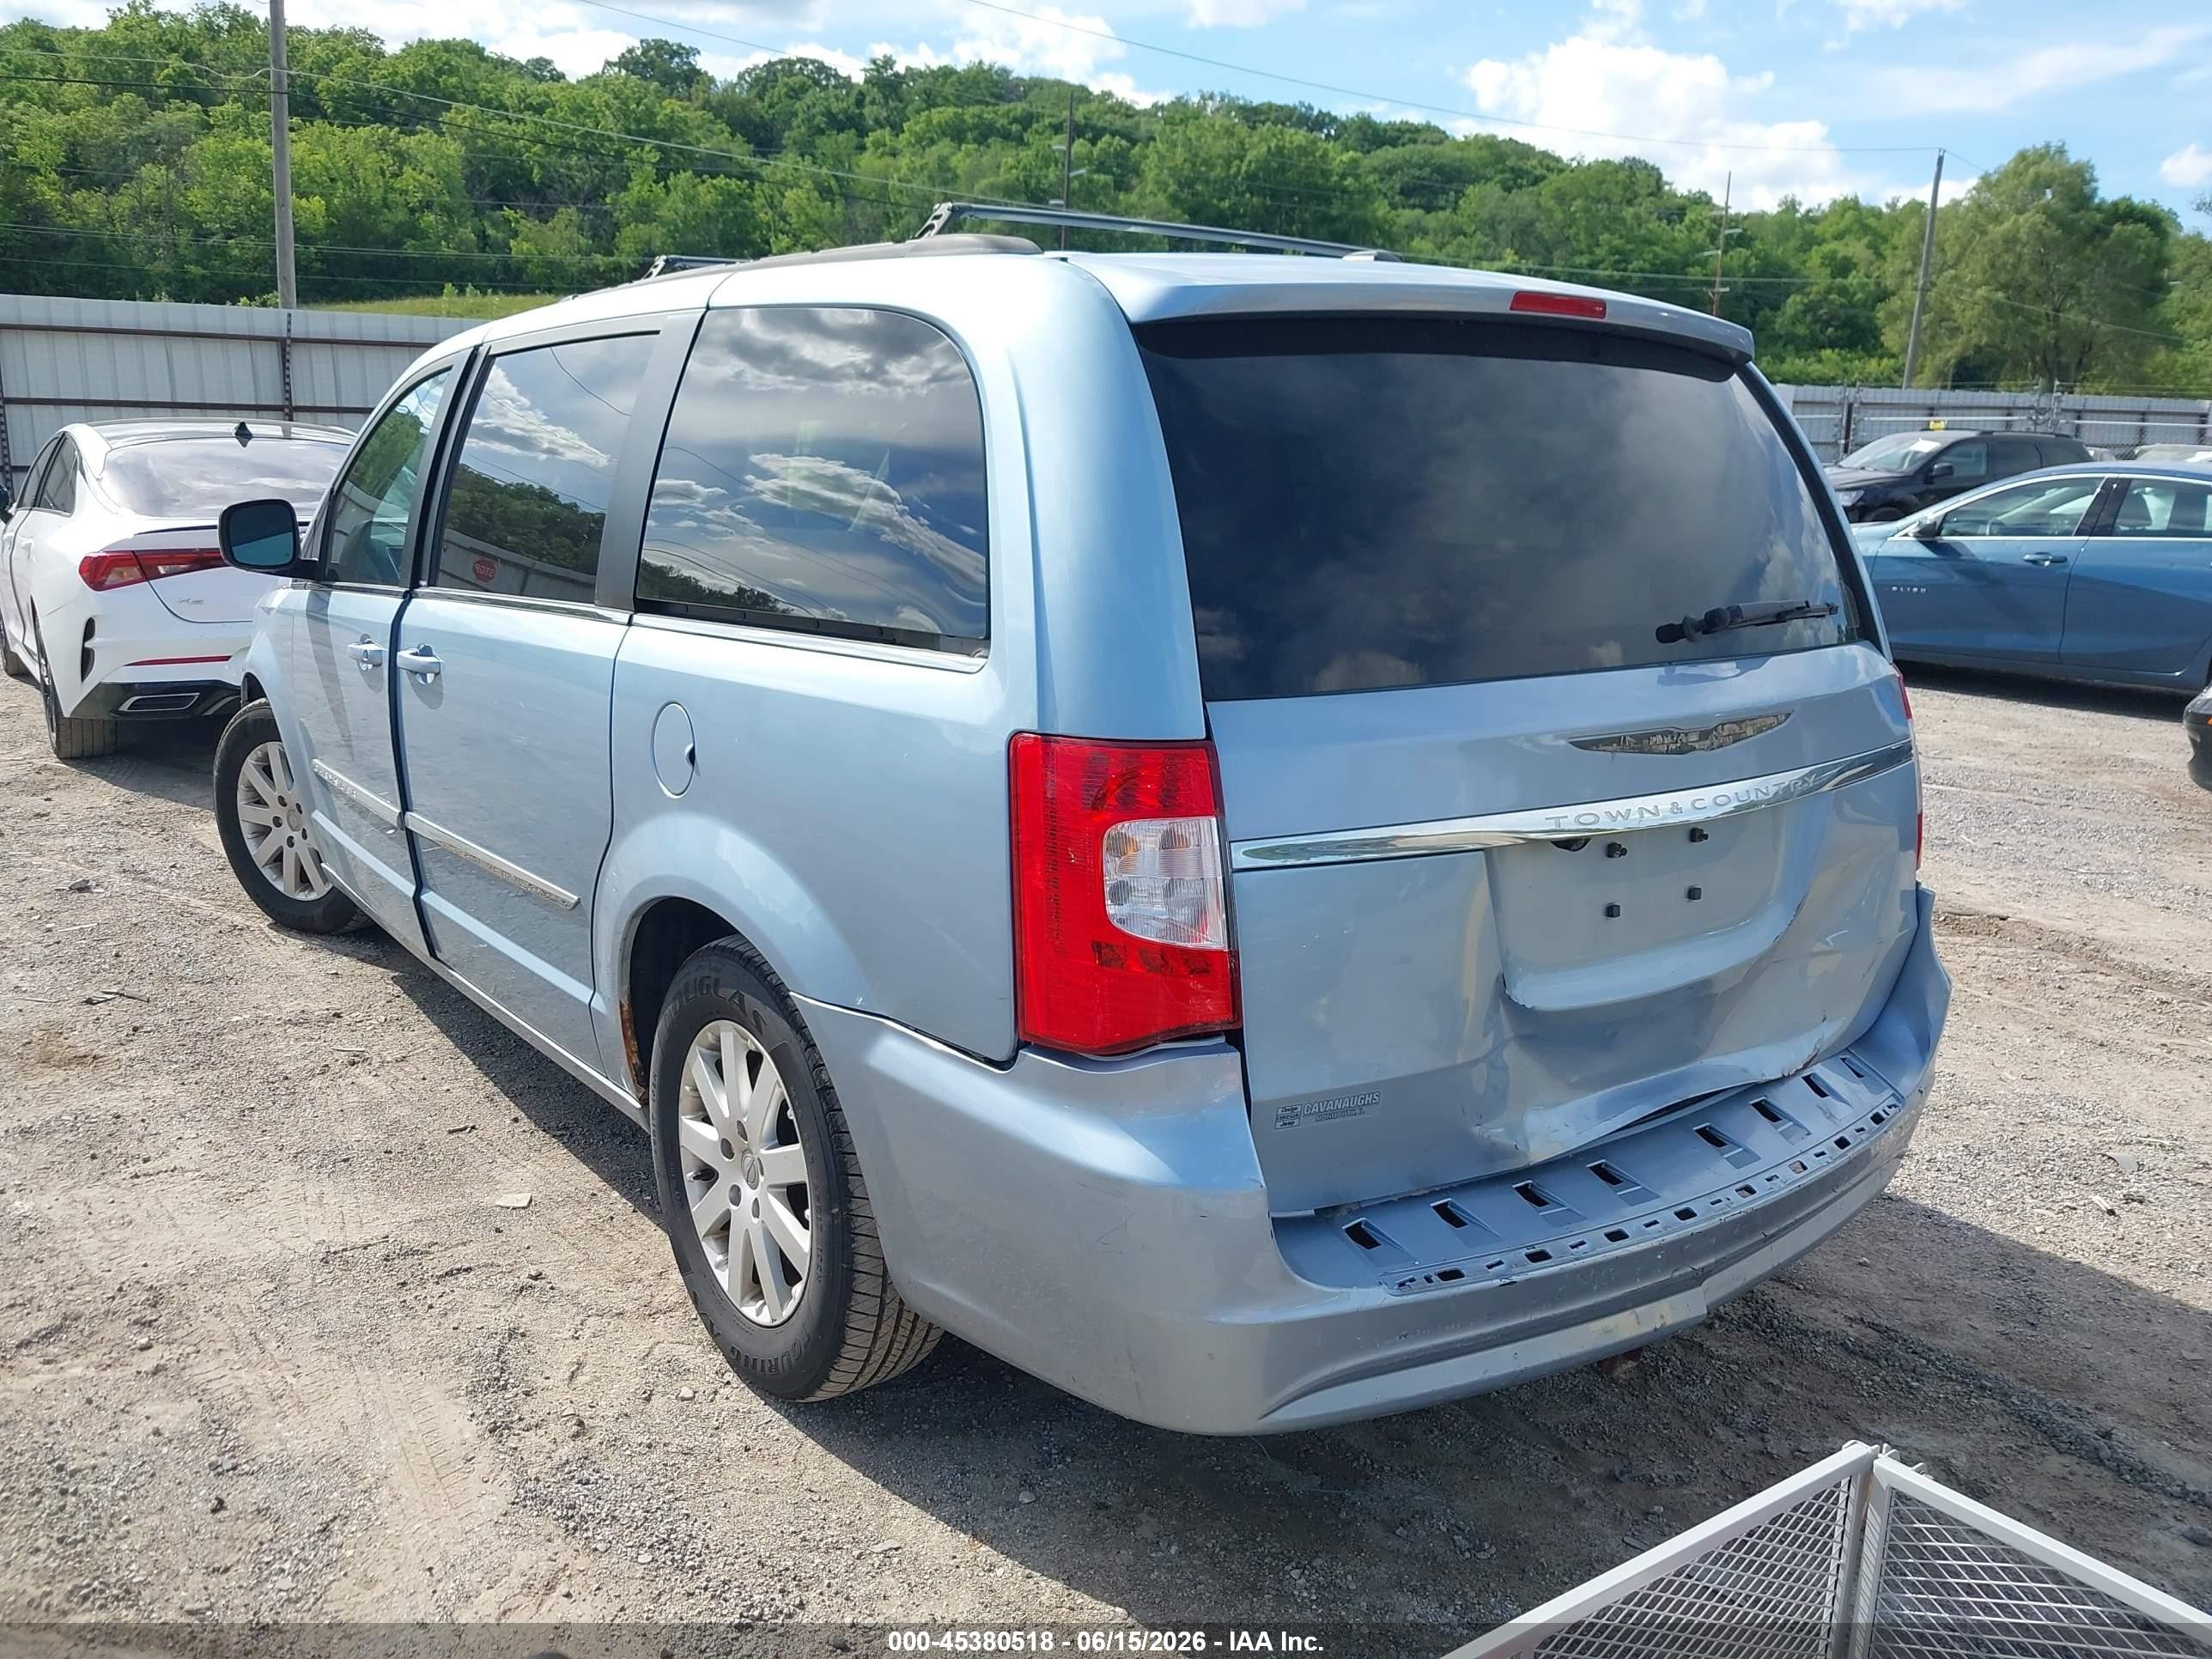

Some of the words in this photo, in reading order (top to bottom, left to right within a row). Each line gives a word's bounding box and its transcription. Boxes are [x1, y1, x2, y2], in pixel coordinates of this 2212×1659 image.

[1546, 805, 1661, 829] TOWN
[1689, 775, 1817, 811] COUNTRY
[1303, 1091, 1381, 1115] CAVANAUGHS
[728, 1325, 811, 1375] TOURING
